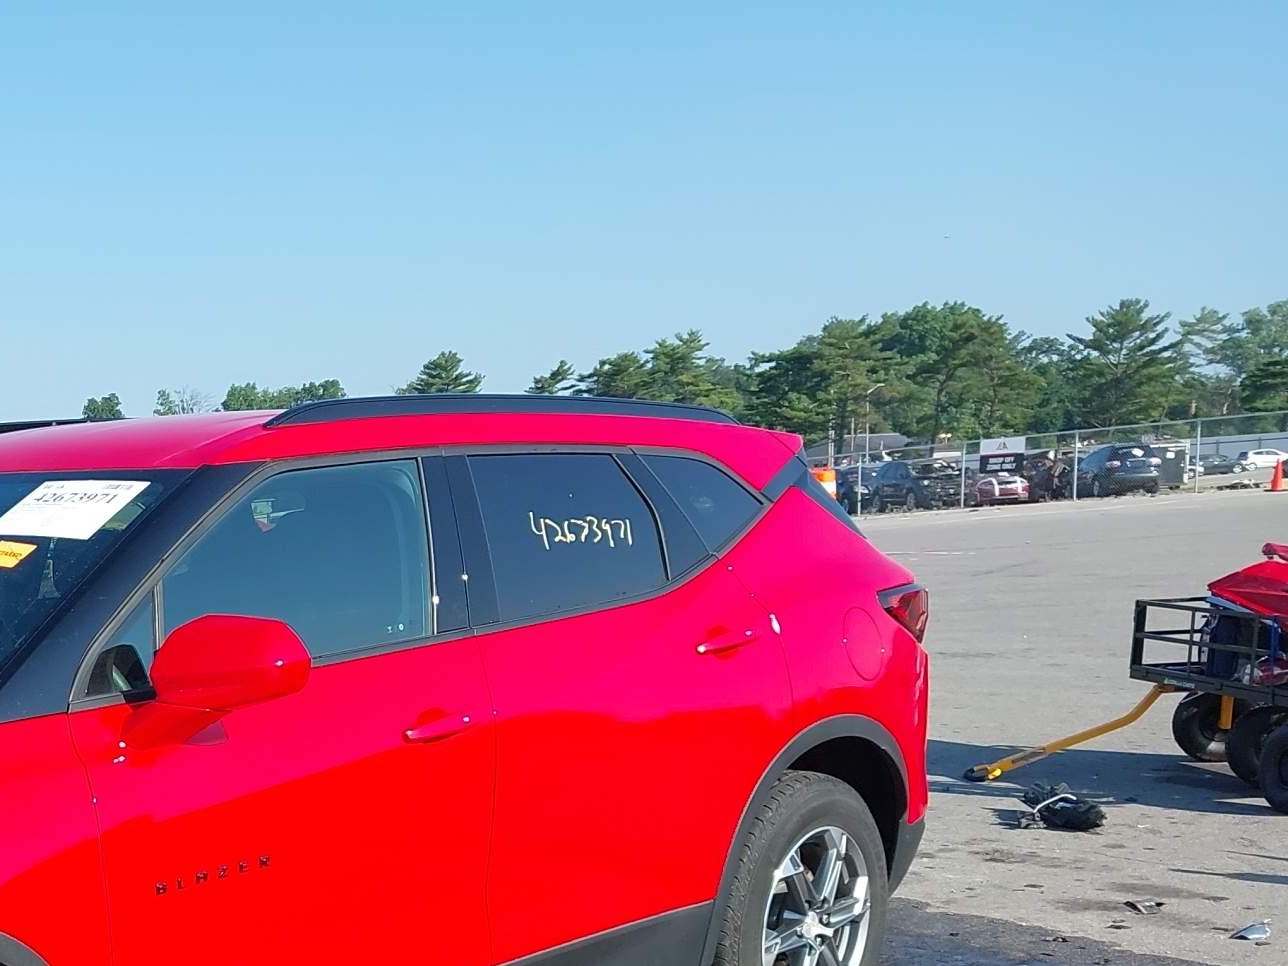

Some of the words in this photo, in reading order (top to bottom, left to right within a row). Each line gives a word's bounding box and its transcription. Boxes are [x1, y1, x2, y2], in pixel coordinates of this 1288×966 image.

[33, 492, 119, 504] 42673971
[529, 511, 633, 551] 42673971
[155, 855, 270, 895] BLAZER
